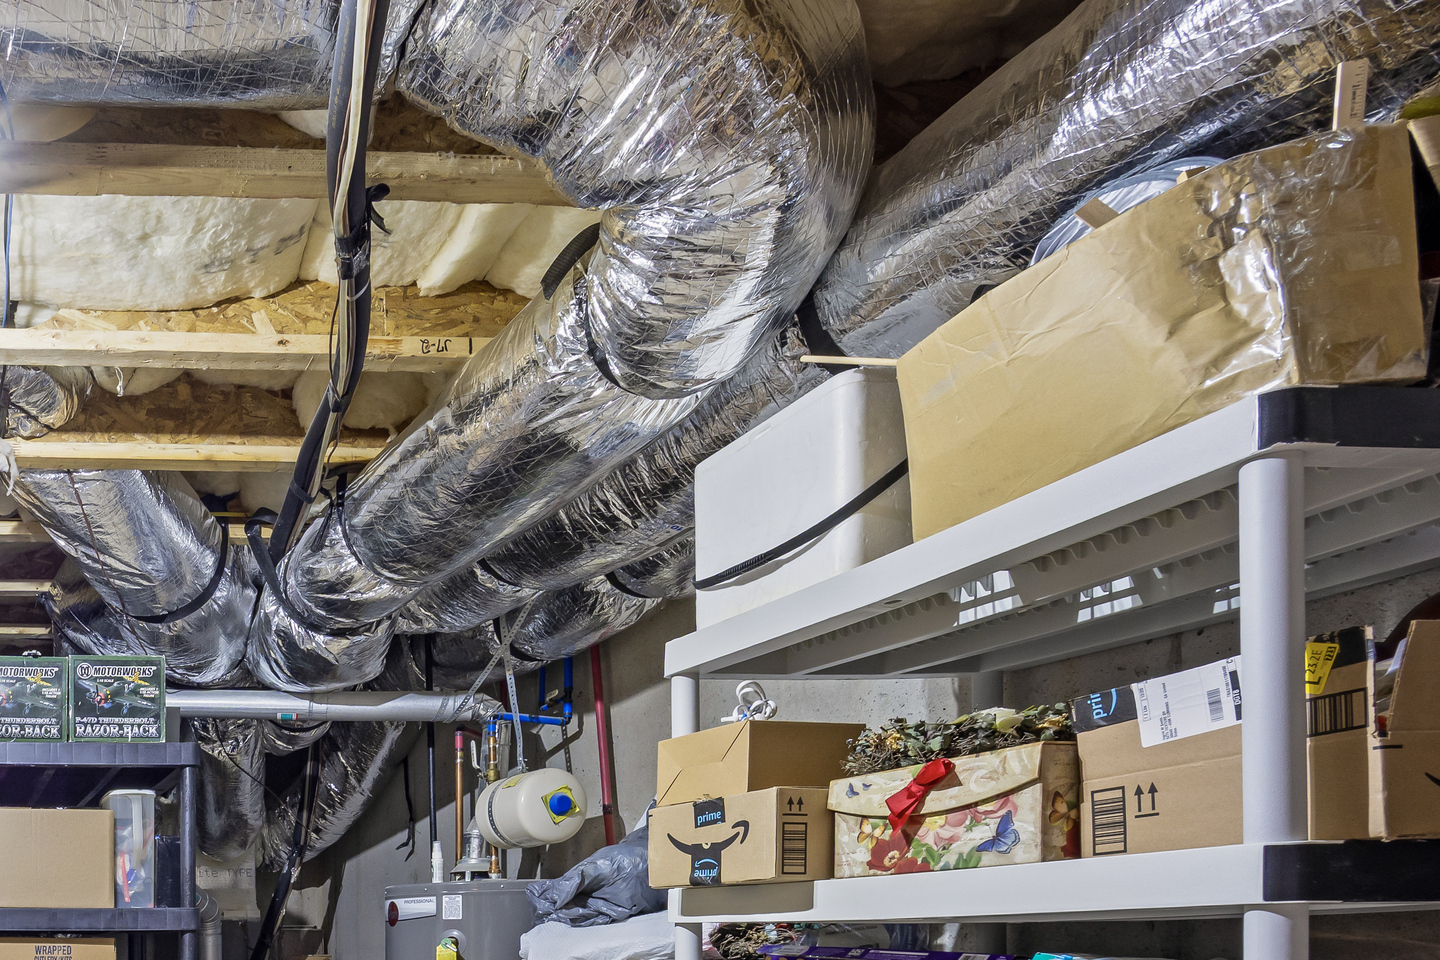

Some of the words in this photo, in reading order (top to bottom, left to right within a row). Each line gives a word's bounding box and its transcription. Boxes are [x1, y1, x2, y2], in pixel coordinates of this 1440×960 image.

[92, 666, 154, 678] MOTORWORKS
[1087, 693, 1107, 719] pri
[75, 724, 159, 738] RAZOR-BACK
[697, 811, 721, 826] prime
[227, 868, 253, 878] TYPE
[694, 866, 718, 879] prime
[35, 945, 72, 955] WRAPPED
